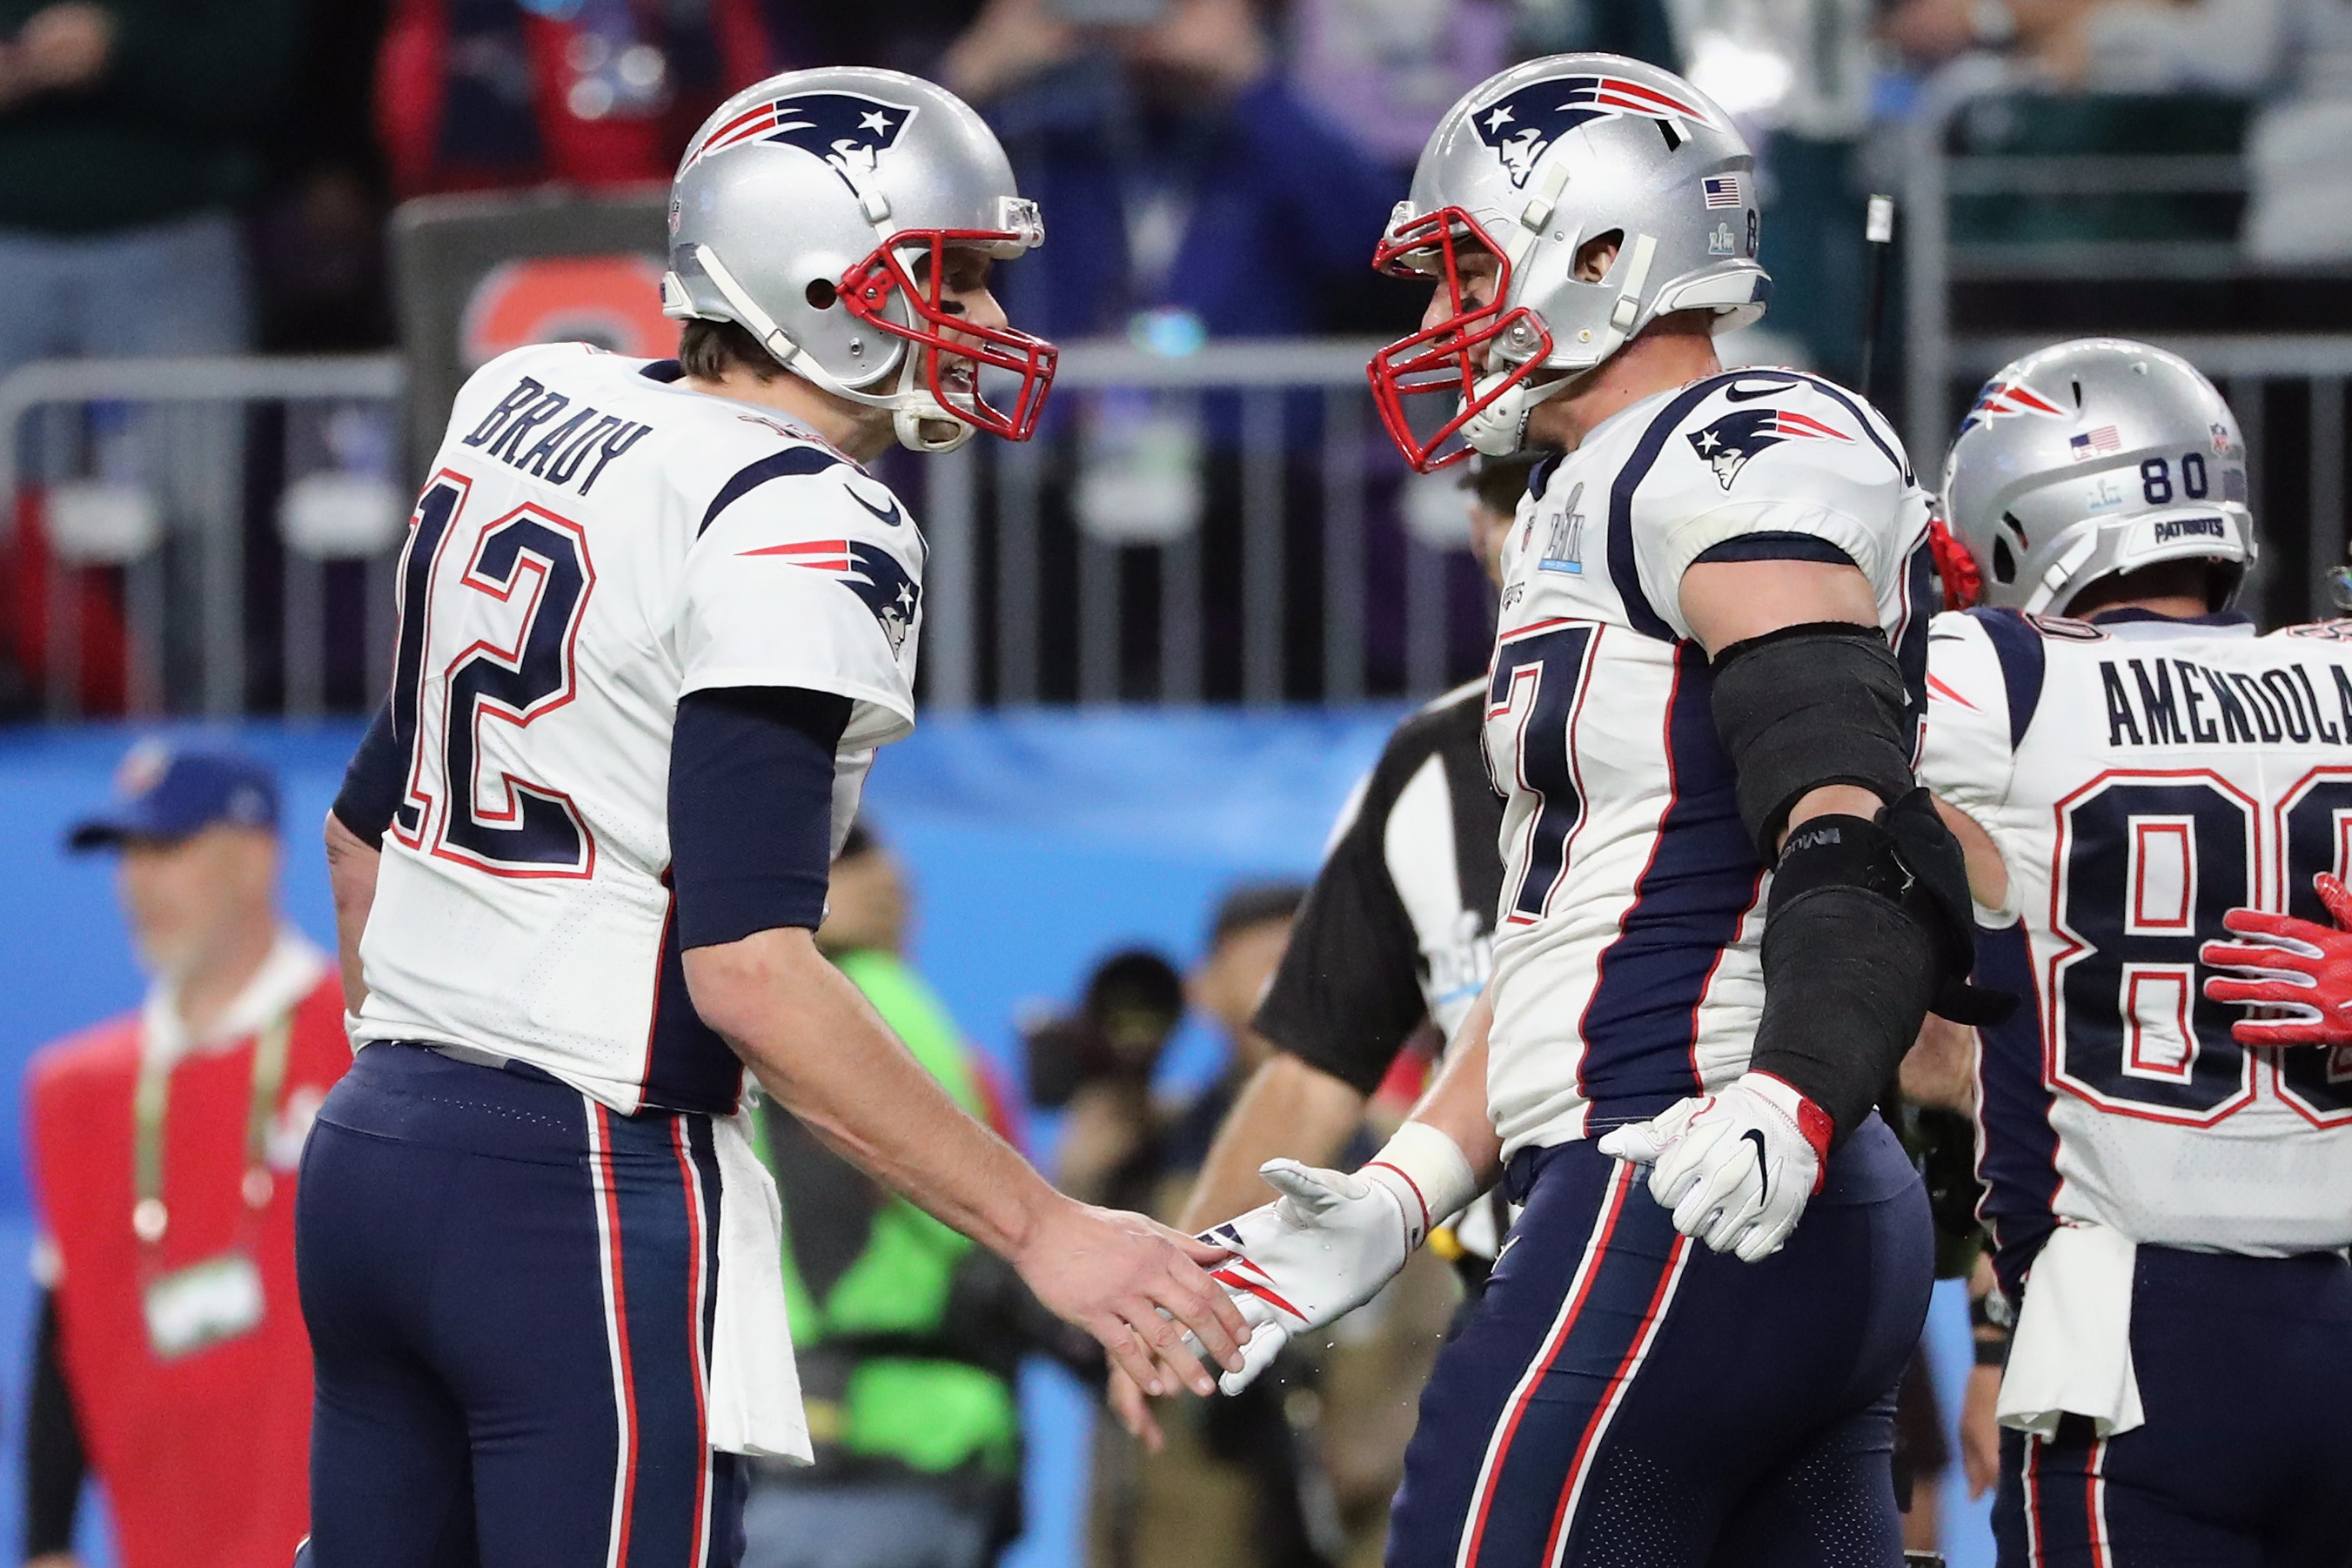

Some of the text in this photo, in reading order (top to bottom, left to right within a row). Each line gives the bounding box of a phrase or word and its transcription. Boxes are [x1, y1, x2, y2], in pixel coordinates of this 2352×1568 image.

[461, 376, 653, 497] BRADY
[2140, 452, 2208, 505] 80
[390, 467, 597, 881] 12
[1481, 618, 1606, 925] 7
